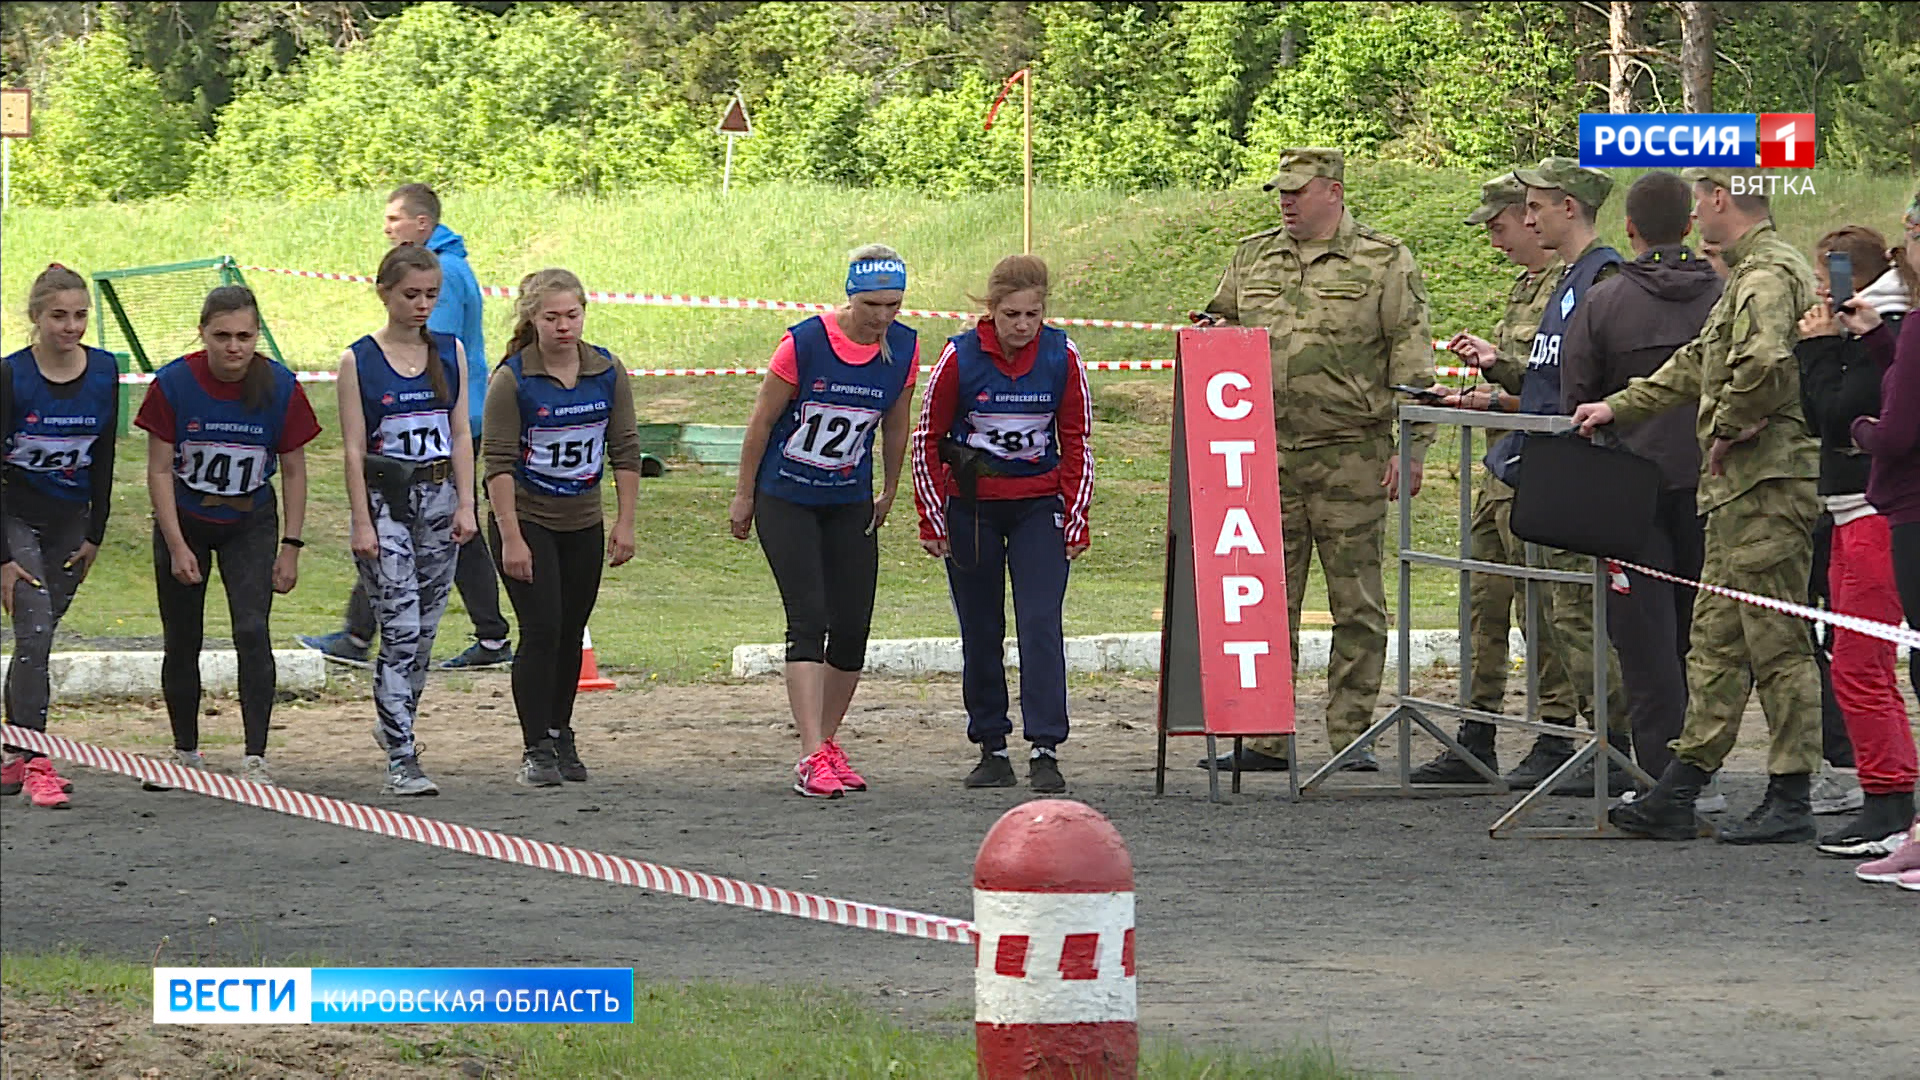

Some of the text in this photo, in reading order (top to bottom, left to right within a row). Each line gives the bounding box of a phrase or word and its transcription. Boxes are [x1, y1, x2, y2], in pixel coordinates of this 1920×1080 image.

[995, 393, 1038, 402] КИРОВСКИЙ
[397, 425, 442, 456] 171
[802, 413, 870, 458] 121
[986, 428, 1038, 451] 181
[27, 449, 80, 467] 161
[546, 437, 594, 468] 151
[187, 450, 255, 492] 141
[1205, 371, 1270, 688] СТАРТ
